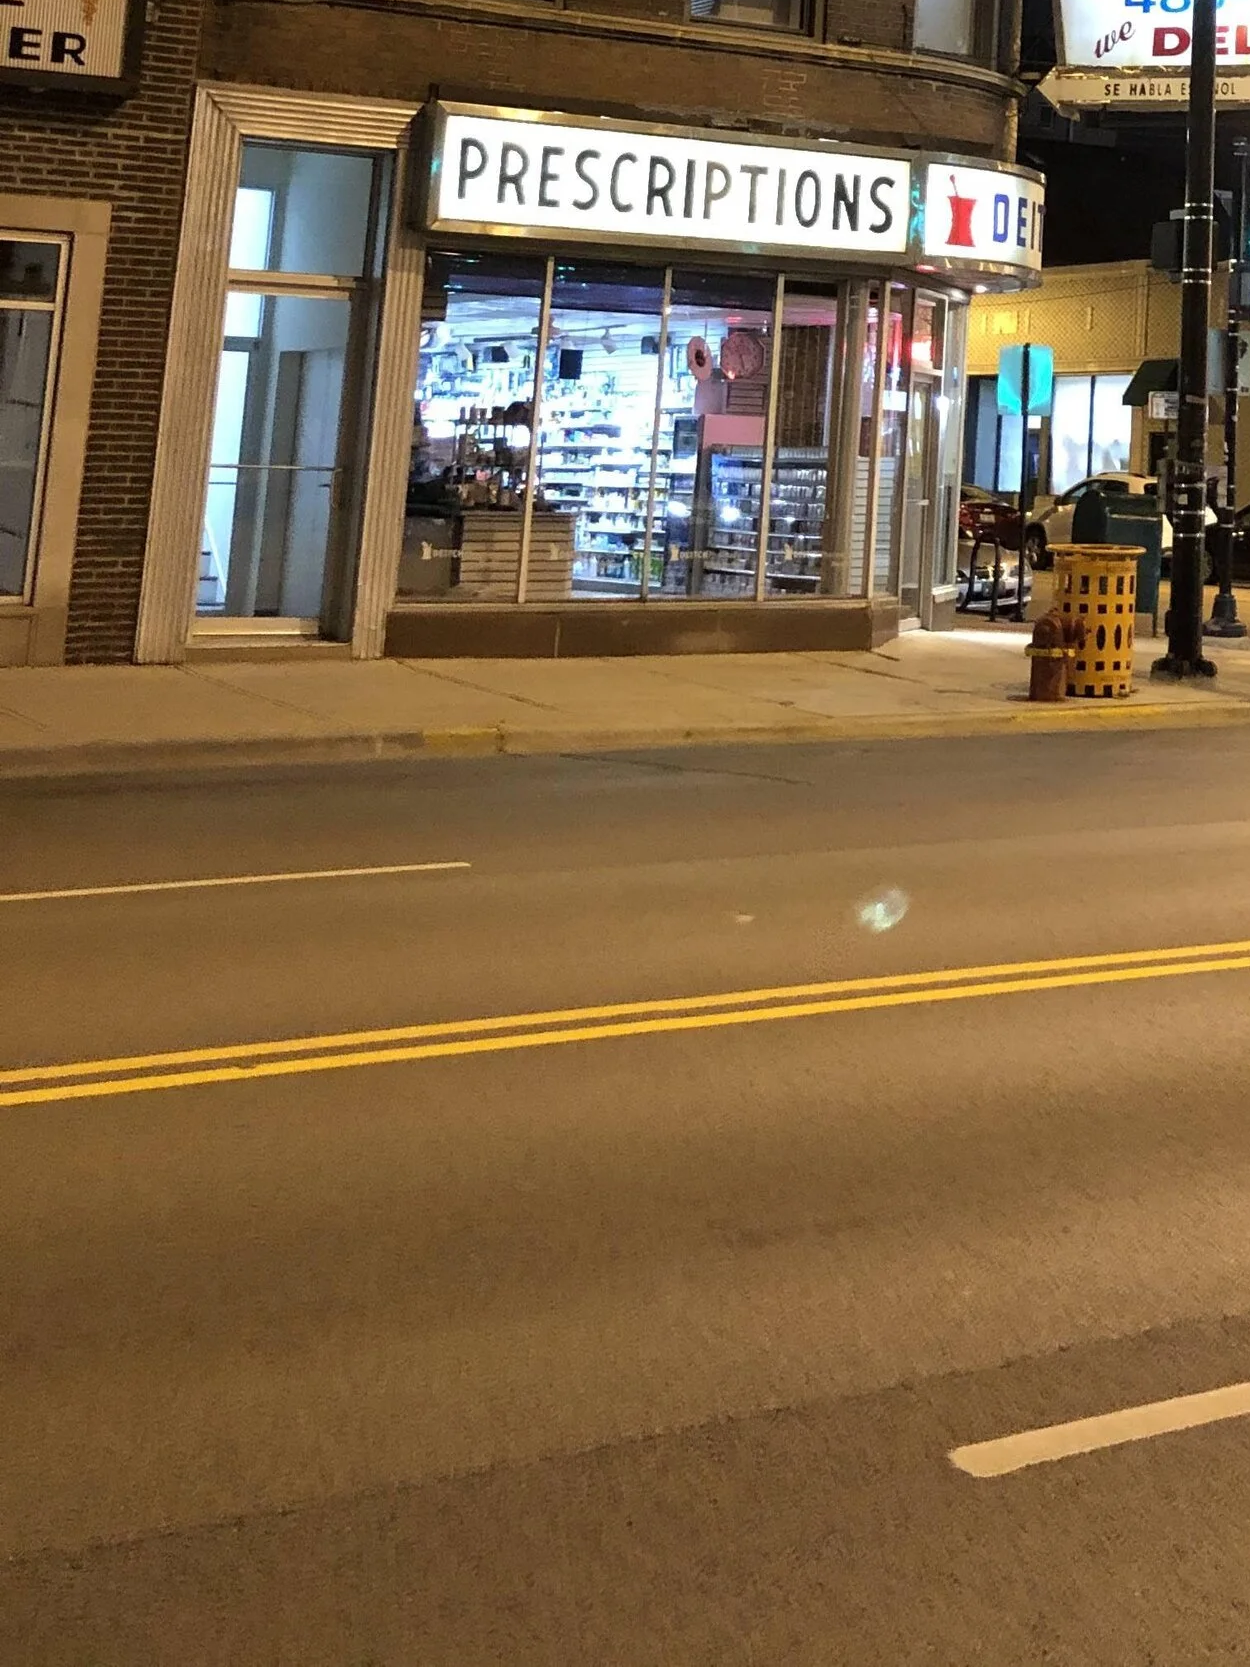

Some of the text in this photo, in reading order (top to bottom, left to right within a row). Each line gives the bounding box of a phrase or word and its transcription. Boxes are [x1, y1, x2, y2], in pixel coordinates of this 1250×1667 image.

[8, 26, 87, 66] ER
[1094, 21, 1136, 58] we
[1104, 83, 1121, 96] SE
[1129, 82, 1172, 96] HABLA
[458, 137, 896, 234] PRESCRIPTIONS
